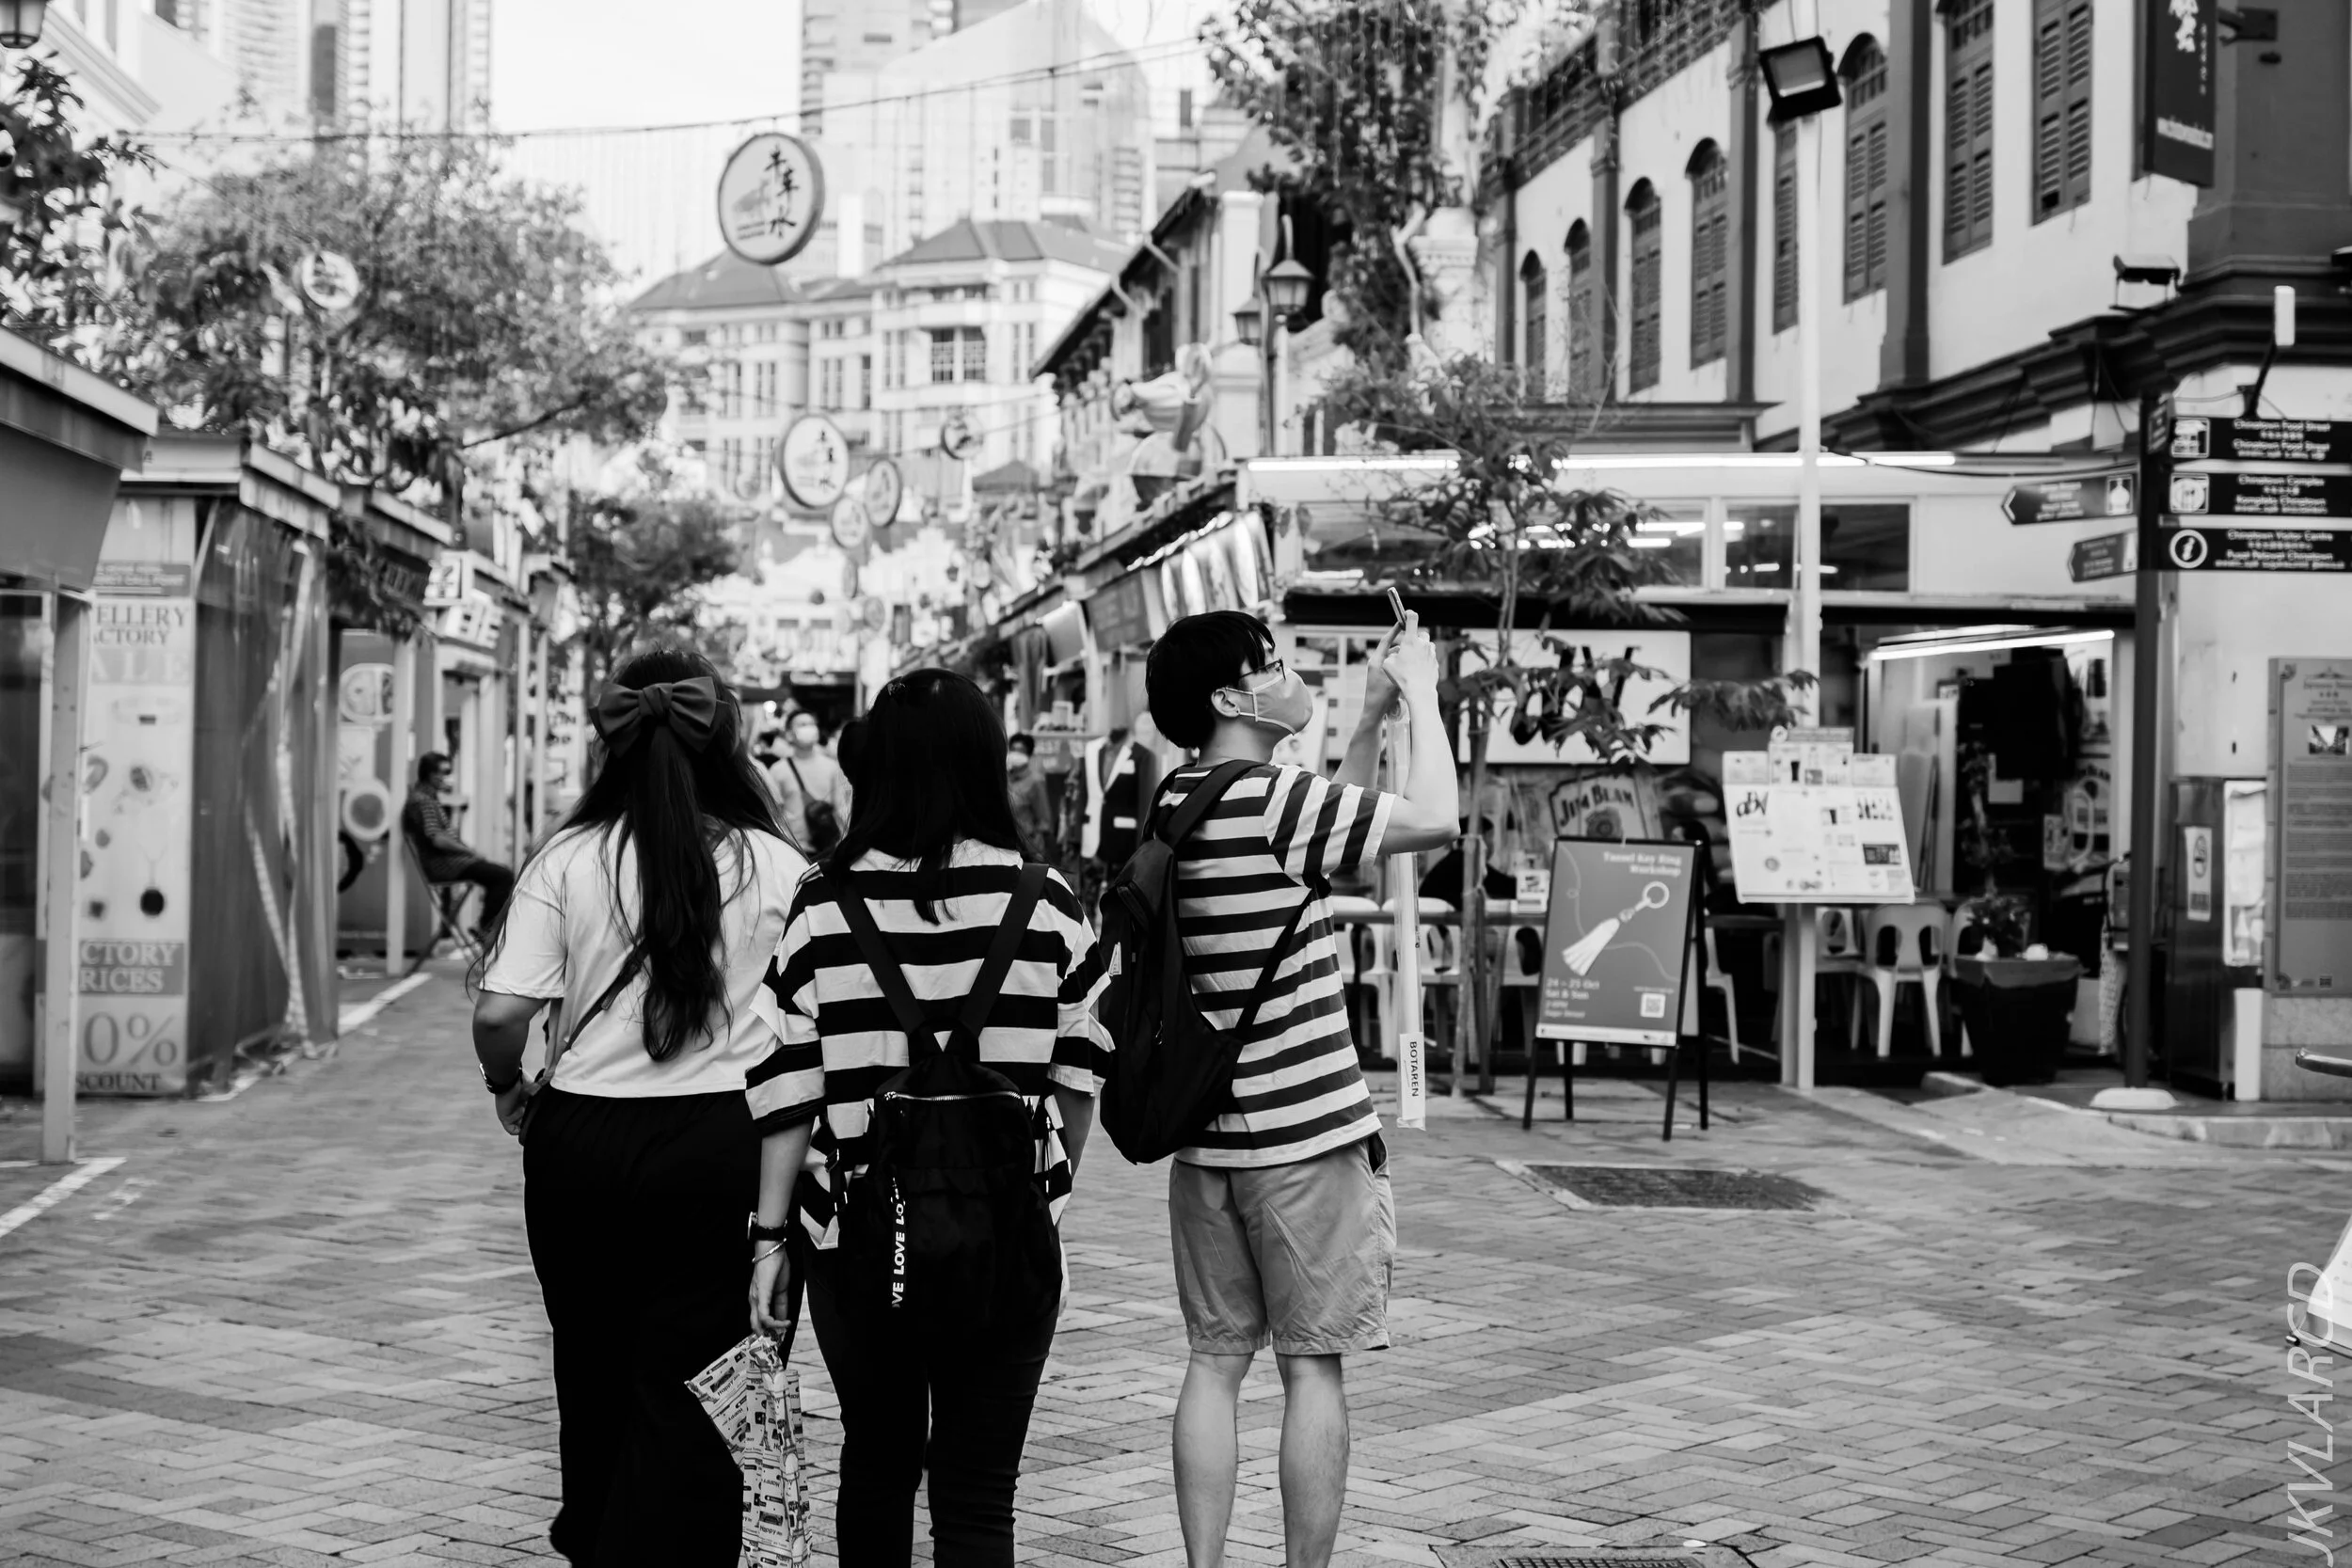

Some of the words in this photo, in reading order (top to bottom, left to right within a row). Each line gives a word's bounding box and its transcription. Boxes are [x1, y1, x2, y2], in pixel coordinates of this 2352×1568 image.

[1409, 1040, 1420, 1098] BOTAREN
[896, 1203, 905, 1226] LO
[893, 1231, 905, 1275] LOVE
